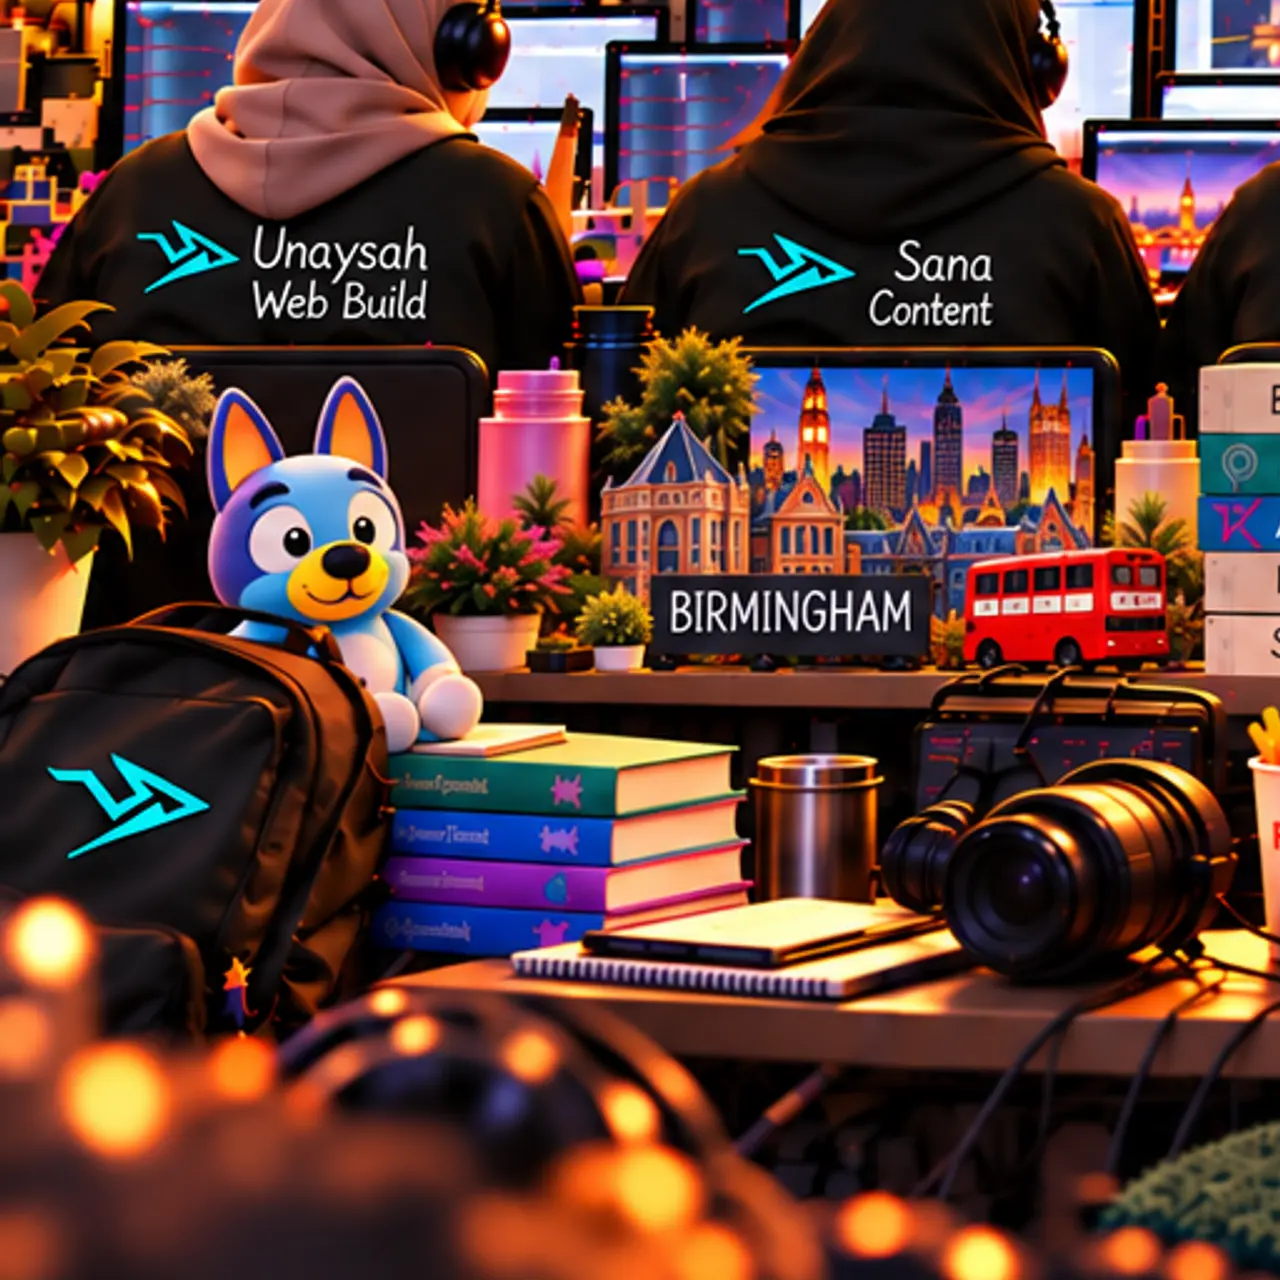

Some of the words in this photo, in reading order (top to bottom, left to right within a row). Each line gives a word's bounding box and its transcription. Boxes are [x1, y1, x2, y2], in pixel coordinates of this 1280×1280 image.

[255, 226, 427, 283] Unaysah
[895, 240, 991, 281] Sana
[253, 280, 328, 318] Web
[343, 280, 426, 319] Build
[870, 289, 992, 326] Content
[672, 590, 910, 632] BIRMINGHAM
